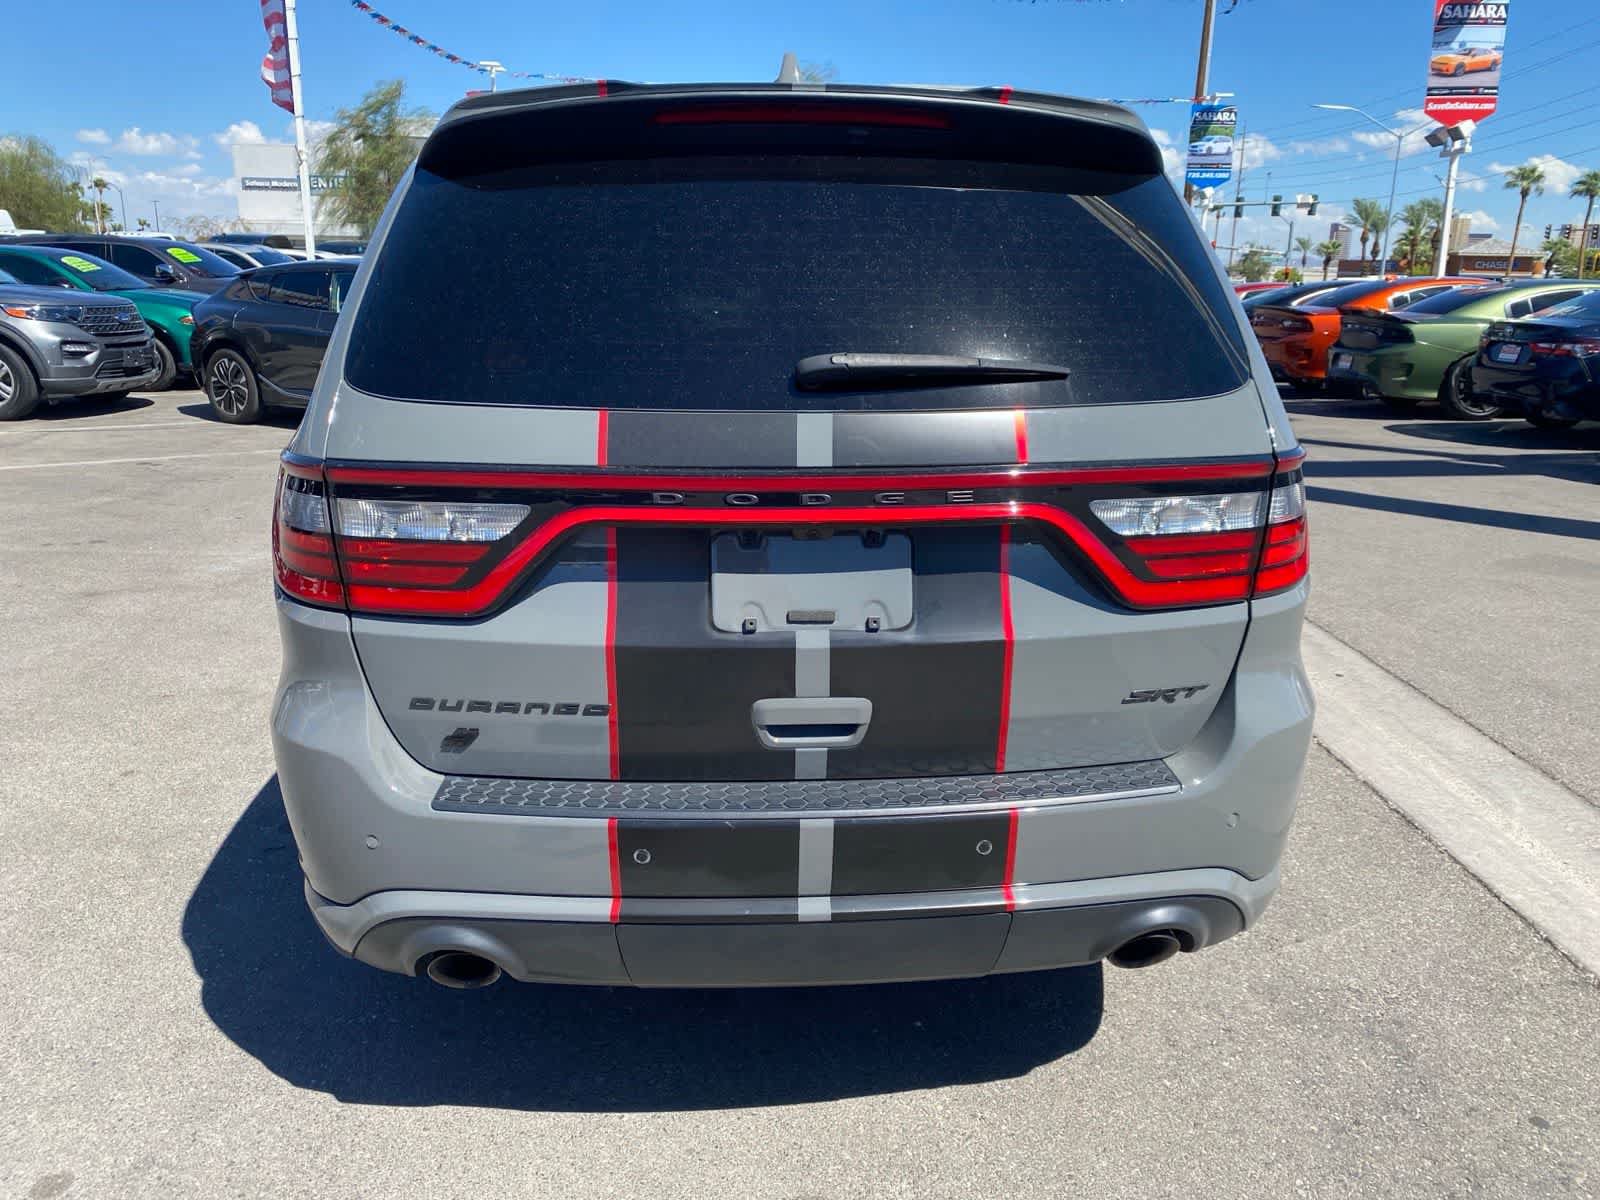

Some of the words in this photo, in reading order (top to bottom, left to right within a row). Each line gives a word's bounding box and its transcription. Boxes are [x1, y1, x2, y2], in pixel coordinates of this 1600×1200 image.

[1443, 4, 1507, 19] SAHARA
[1195, 111, 1236, 121] SAHARA
[652, 491, 975, 506] DODGE
[1121, 684, 1209, 704] SRT
[408, 697, 611, 717] DURANGO
